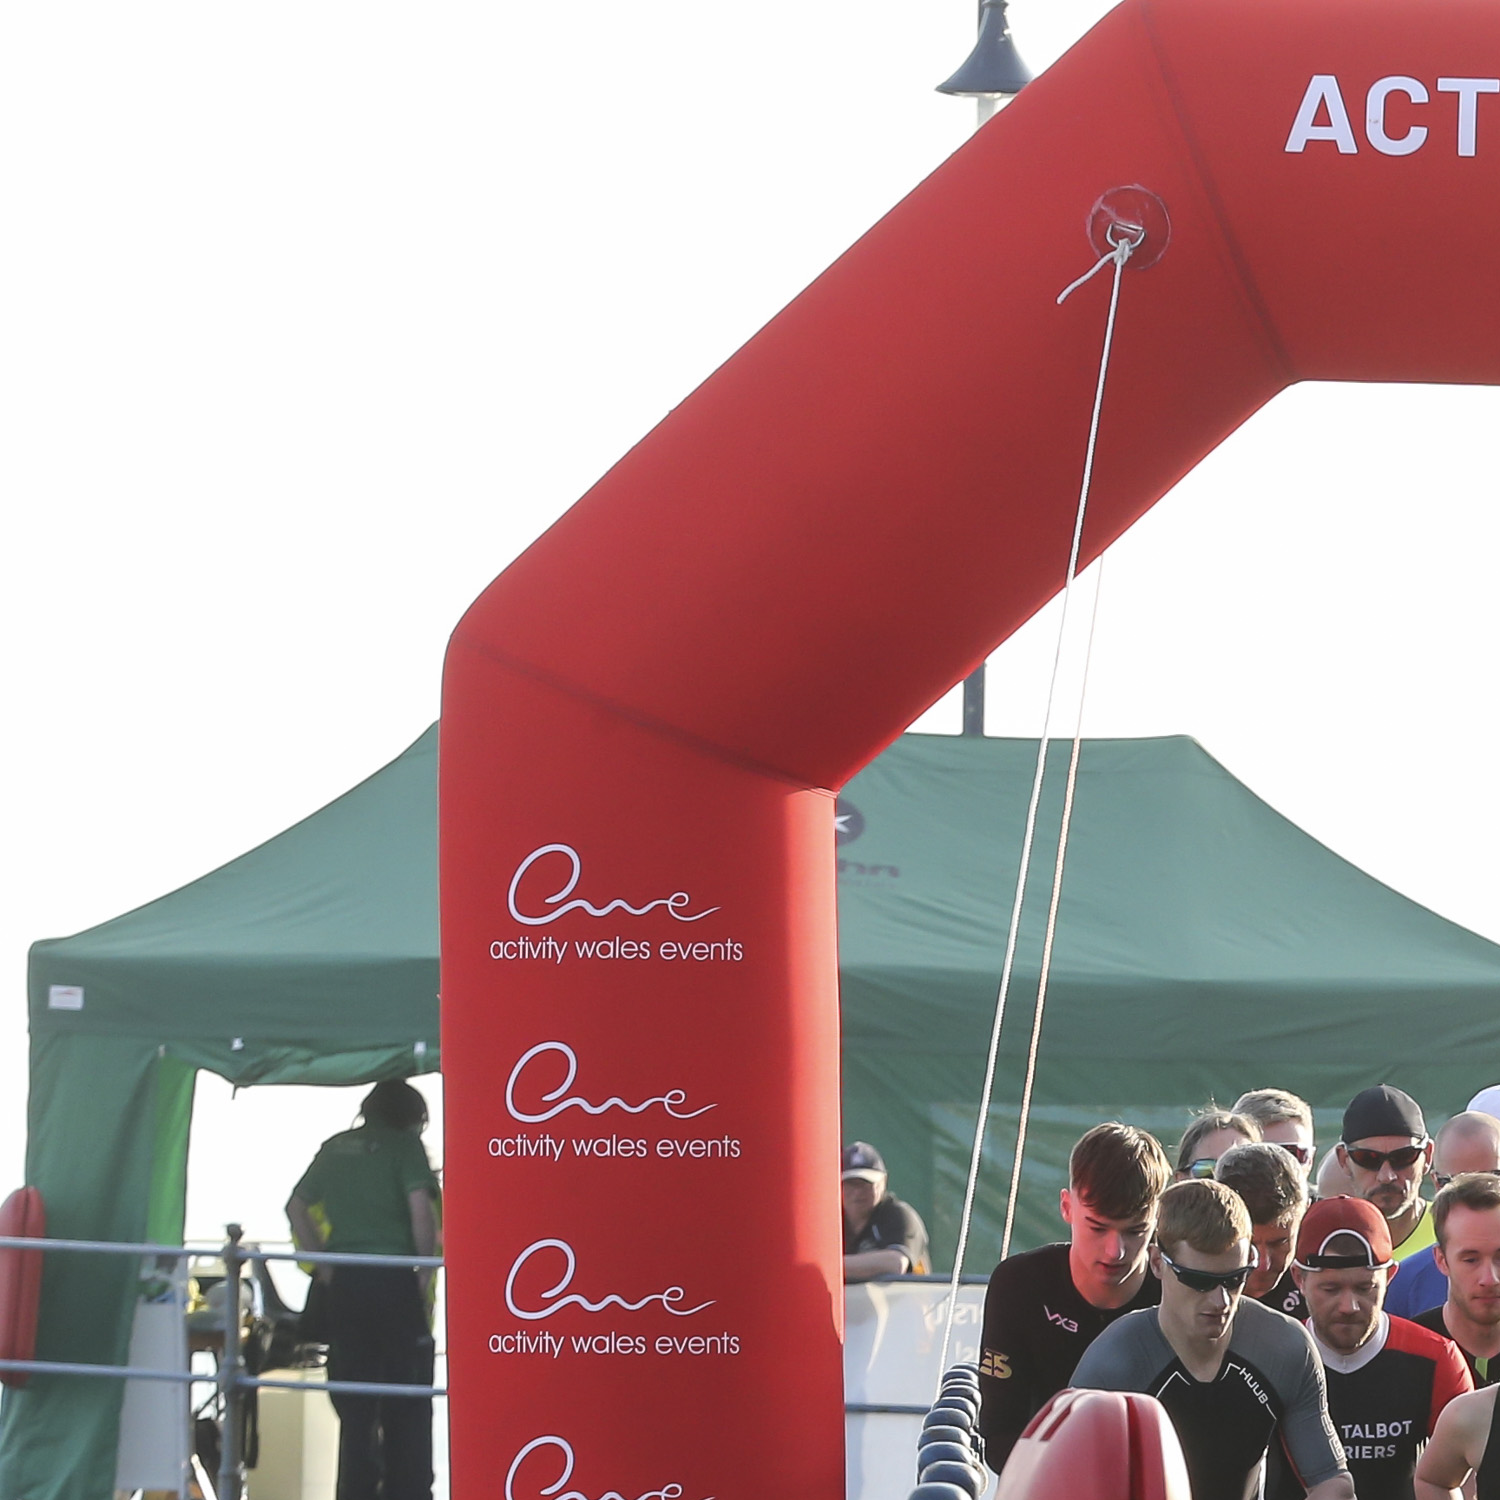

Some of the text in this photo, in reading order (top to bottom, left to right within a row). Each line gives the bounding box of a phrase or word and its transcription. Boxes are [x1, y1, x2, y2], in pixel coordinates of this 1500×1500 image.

[491, 937, 742, 963] activity wales events
[489, 1134, 740, 1161] activity wales events
[489, 1331, 739, 1358] activity wales events
[1239, 1367, 1268, 1405] HUUB
[1341, 1420, 1413, 1440] TALBOT
